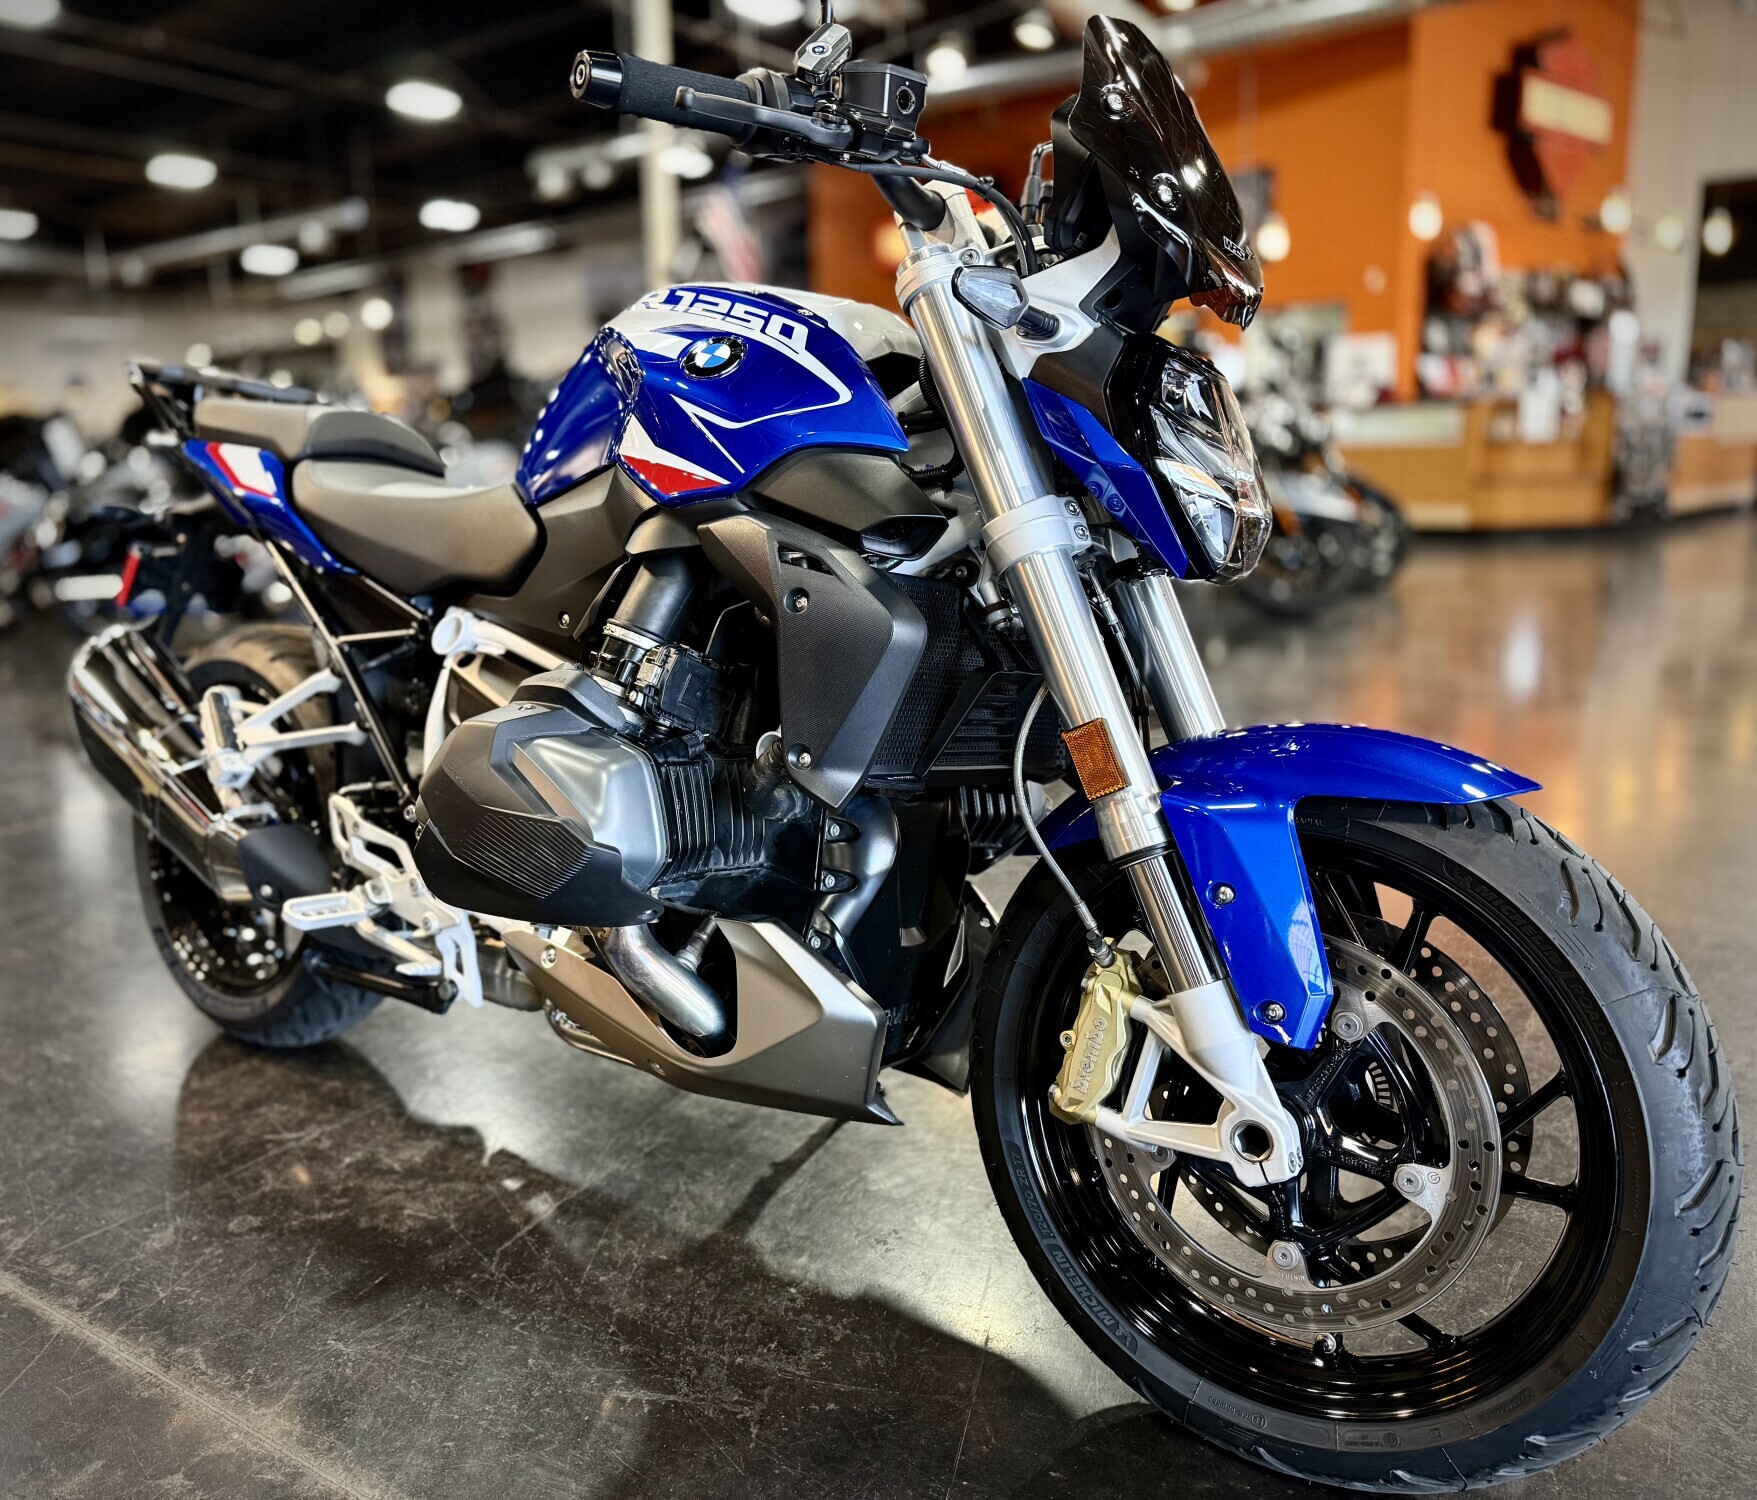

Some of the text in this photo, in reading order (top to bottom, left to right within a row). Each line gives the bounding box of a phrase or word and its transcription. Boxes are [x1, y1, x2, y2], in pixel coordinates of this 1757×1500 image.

[1477, 884, 1565, 969] MICHELIN
[1570, 984, 1607, 1037] ROAD
[1070, 1017, 1108, 1095] brembo
[1010, 1151, 1052, 1236] 120/70 ZR 17
[1052, 1250, 1116, 1328] MICHELIN
